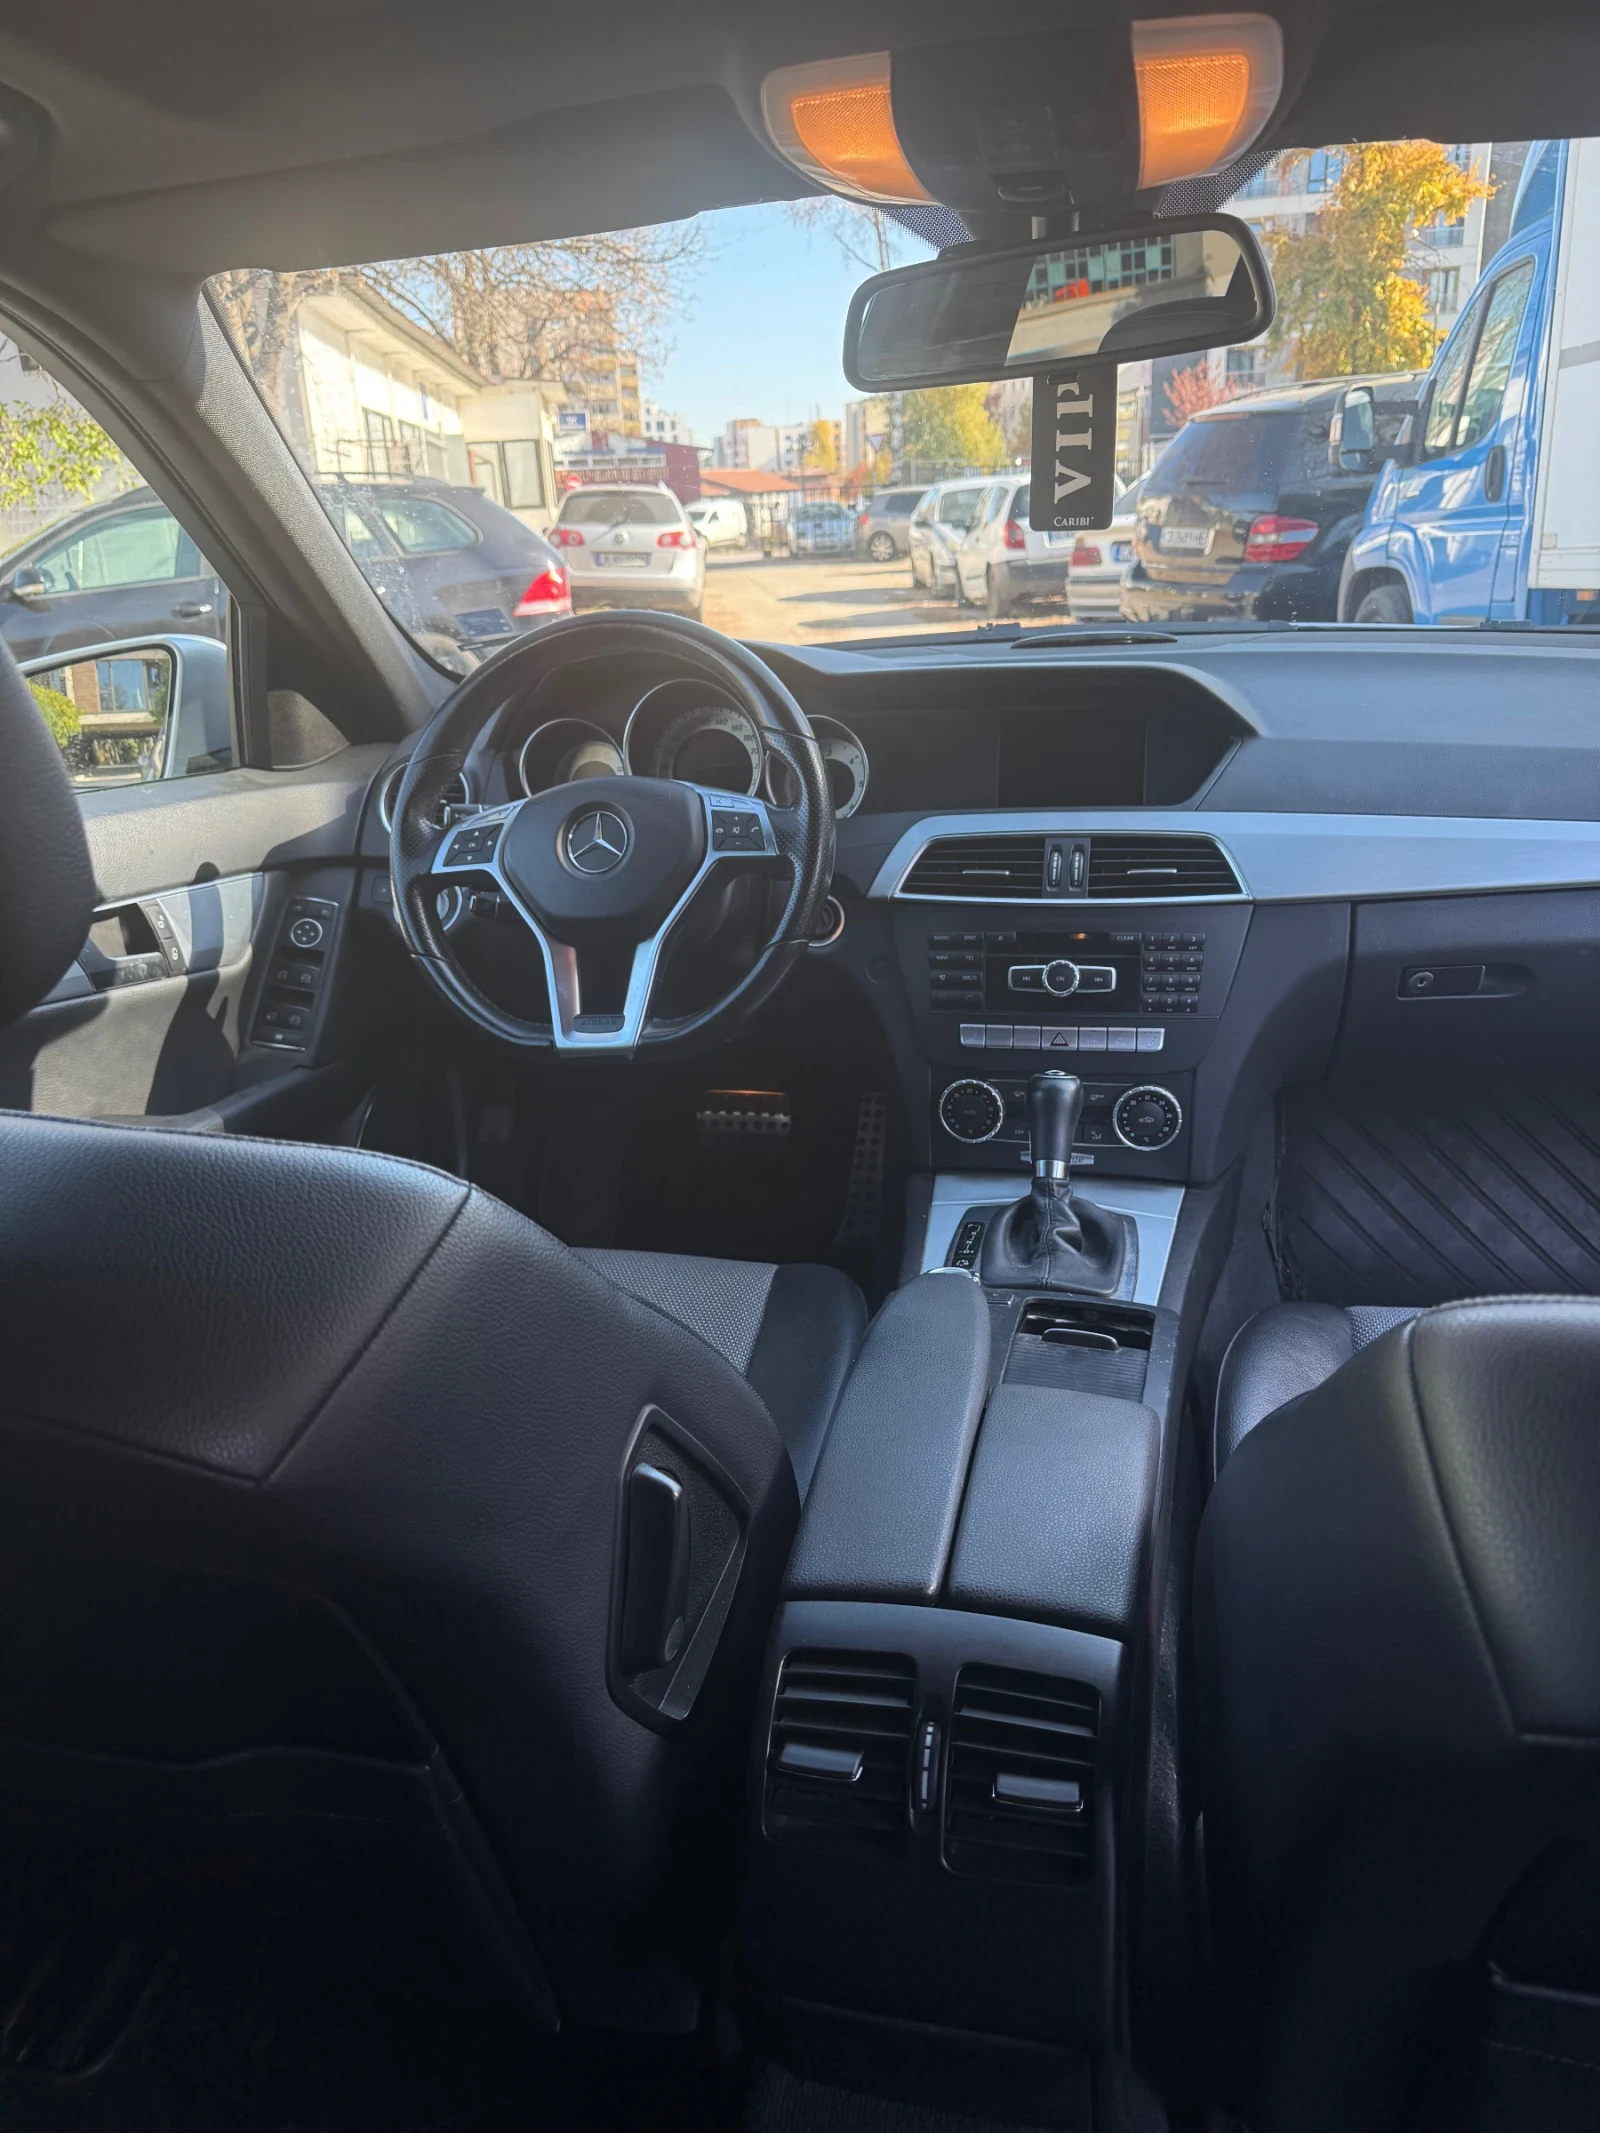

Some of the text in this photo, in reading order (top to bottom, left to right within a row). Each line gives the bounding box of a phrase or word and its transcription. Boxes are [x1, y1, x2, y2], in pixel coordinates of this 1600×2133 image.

[1053, 382, 1093, 504] VIP
[731, 723, 743, 732] 160
[581, 1018, 617, 1026] AIRBAG
